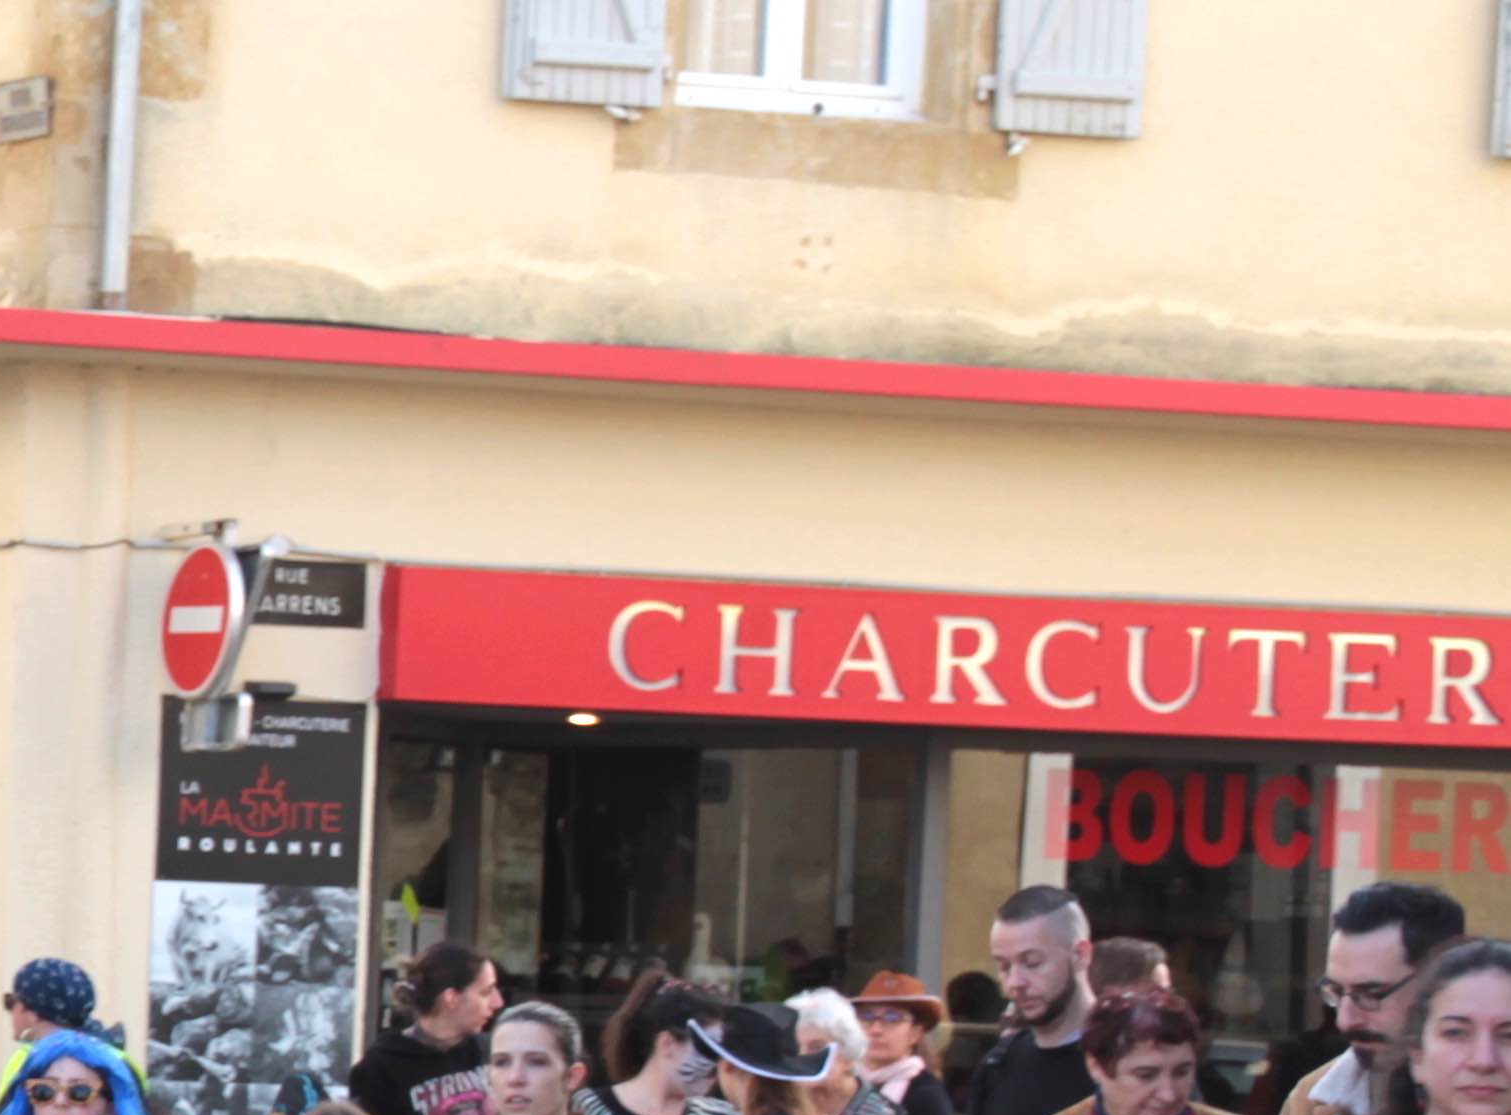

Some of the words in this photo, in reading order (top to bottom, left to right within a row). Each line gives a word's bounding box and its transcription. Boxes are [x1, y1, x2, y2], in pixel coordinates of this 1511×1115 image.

[274, 567, 310, 585] RUE
[258, 594, 342, 616] ARRENS
[606, 599, 1502, 726] CHARCUTER
[261, 714, 352, 733] CHARCUTERIE
[179, 780, 201, 794] LA
[179, 797, 343, 834] MARMITE
[176, 835, 342, 858] ROULANTE
